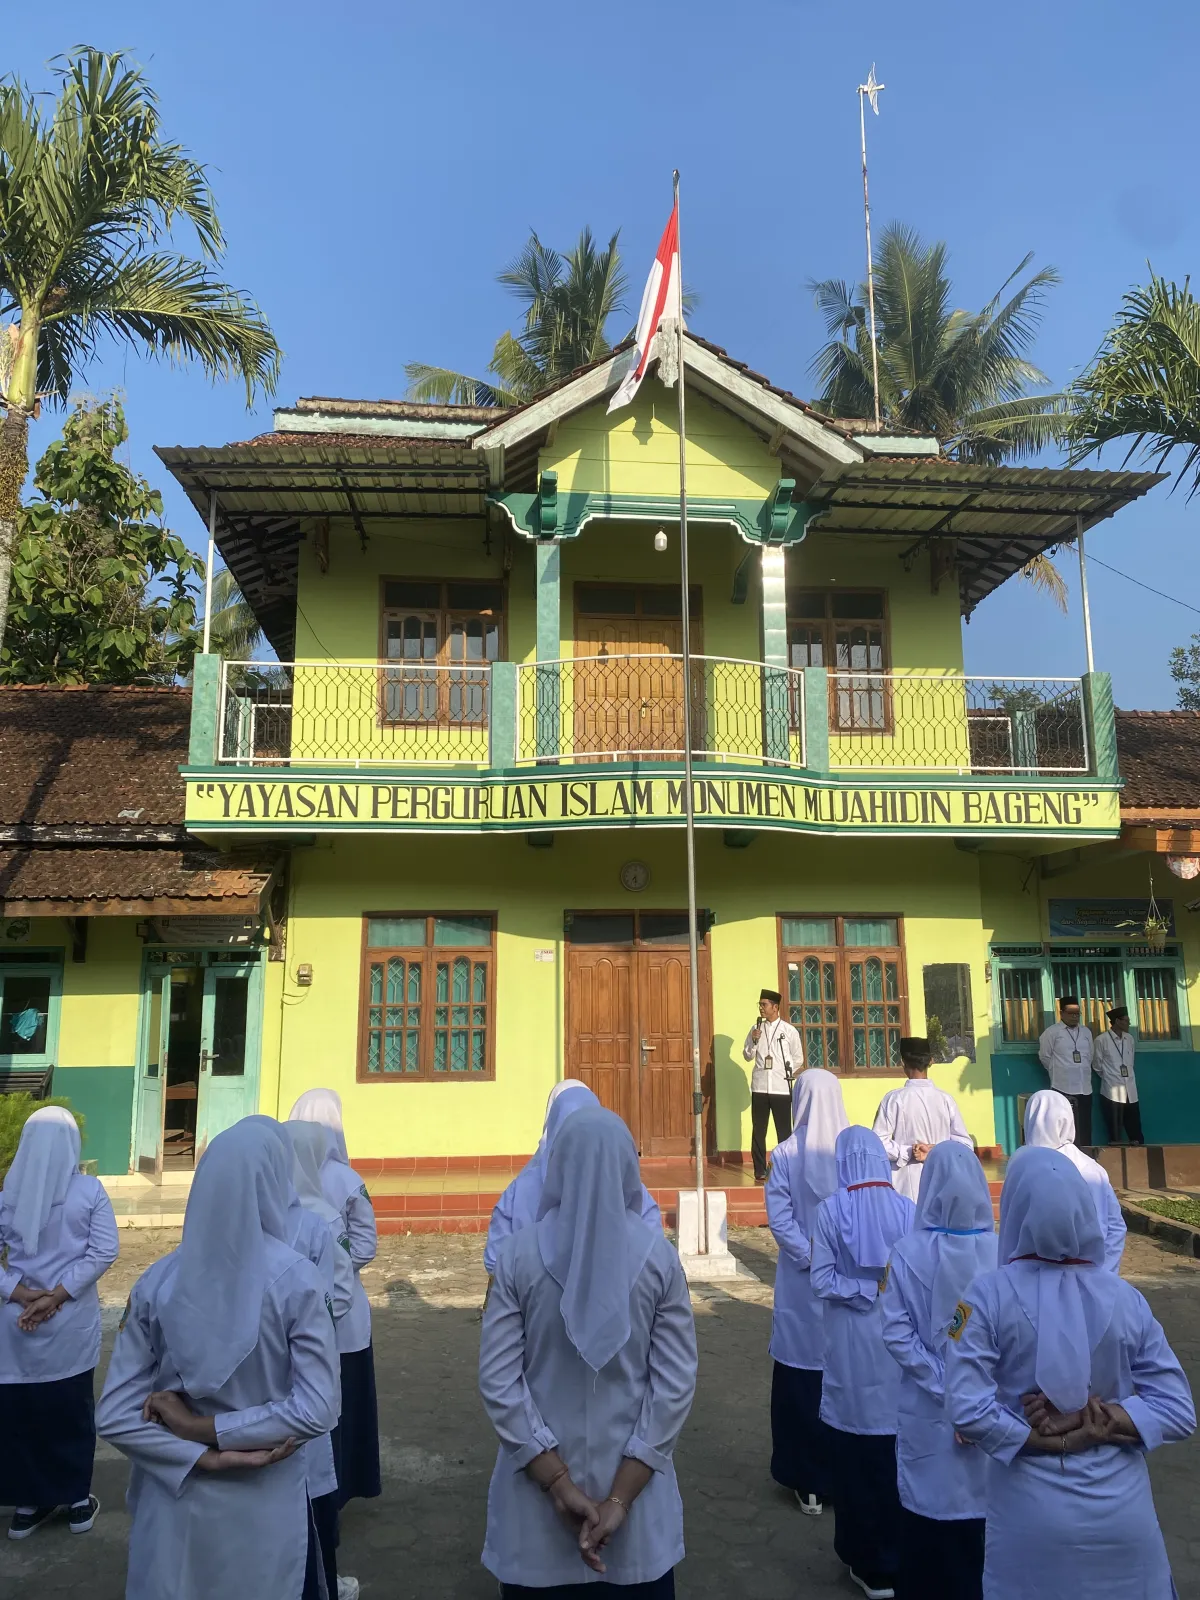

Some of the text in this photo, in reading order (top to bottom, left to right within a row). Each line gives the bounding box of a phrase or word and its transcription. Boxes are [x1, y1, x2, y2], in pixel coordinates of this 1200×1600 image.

[371, 783, 548, 820] PERGURUAN
[560, 780, 655, 817] ISLAM
[666, 780, 796, 819] MONUMEN
[803, 786, 951, 824] MUJAHIDIN
